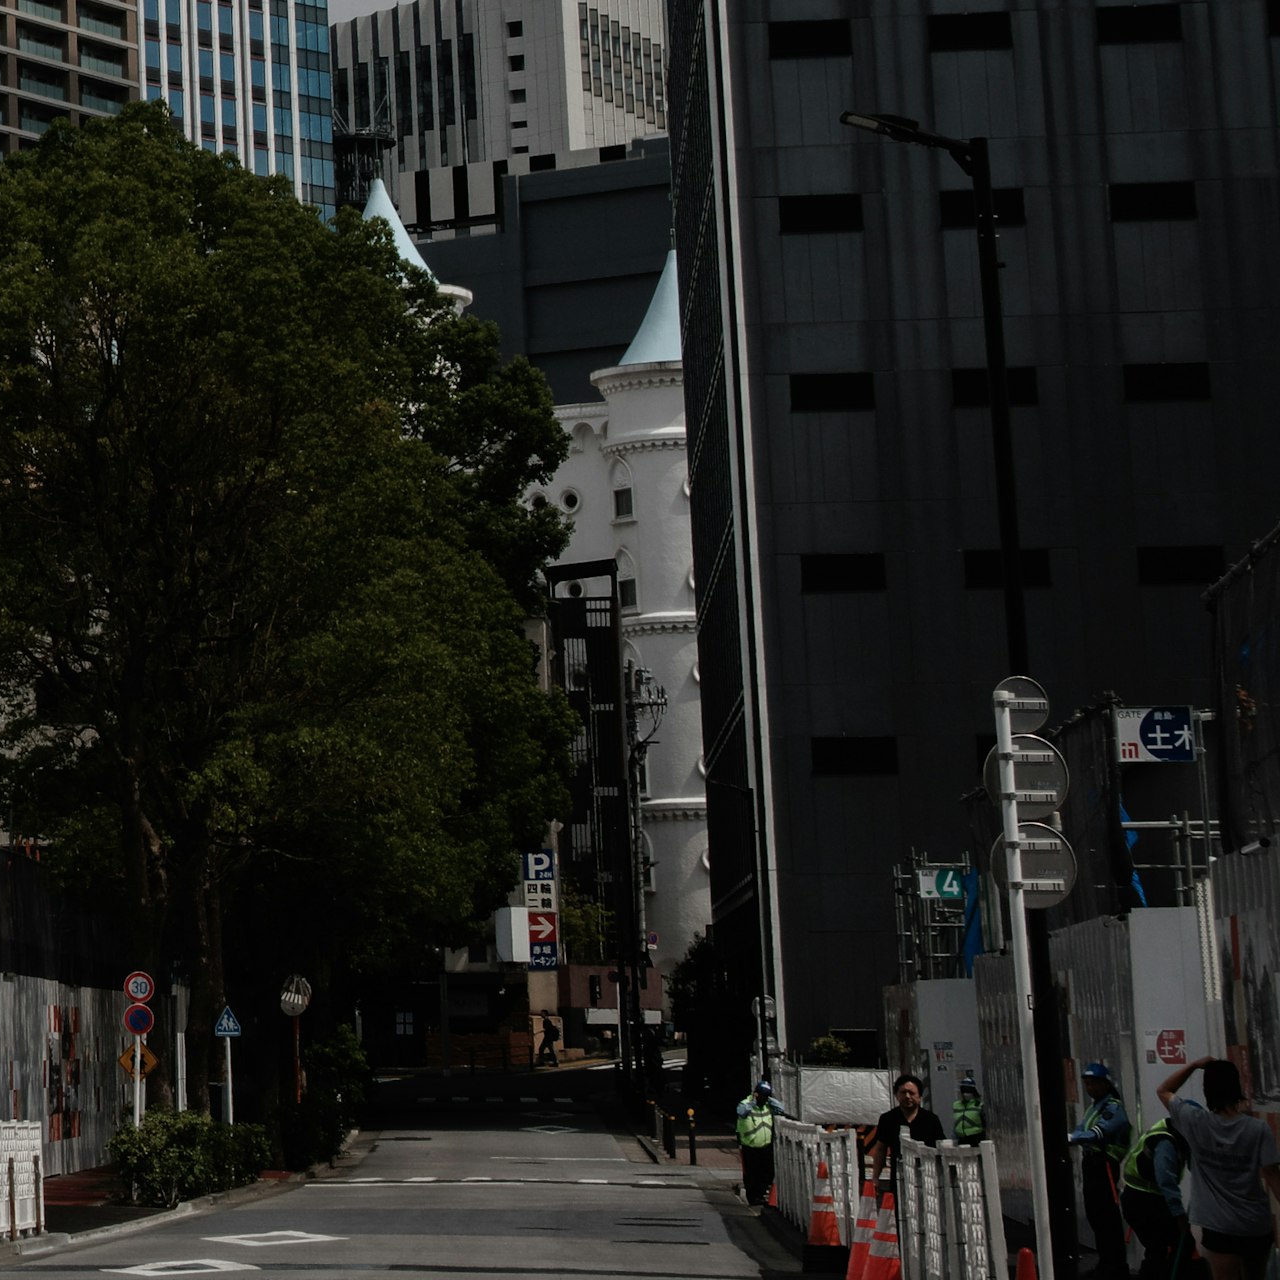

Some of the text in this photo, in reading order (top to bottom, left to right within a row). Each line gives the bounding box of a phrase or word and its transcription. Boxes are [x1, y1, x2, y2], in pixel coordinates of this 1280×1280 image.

[527, 853, 551, 879] P
[943, 871, 959, 895] 4
[131, 980, 148, 995] 30
